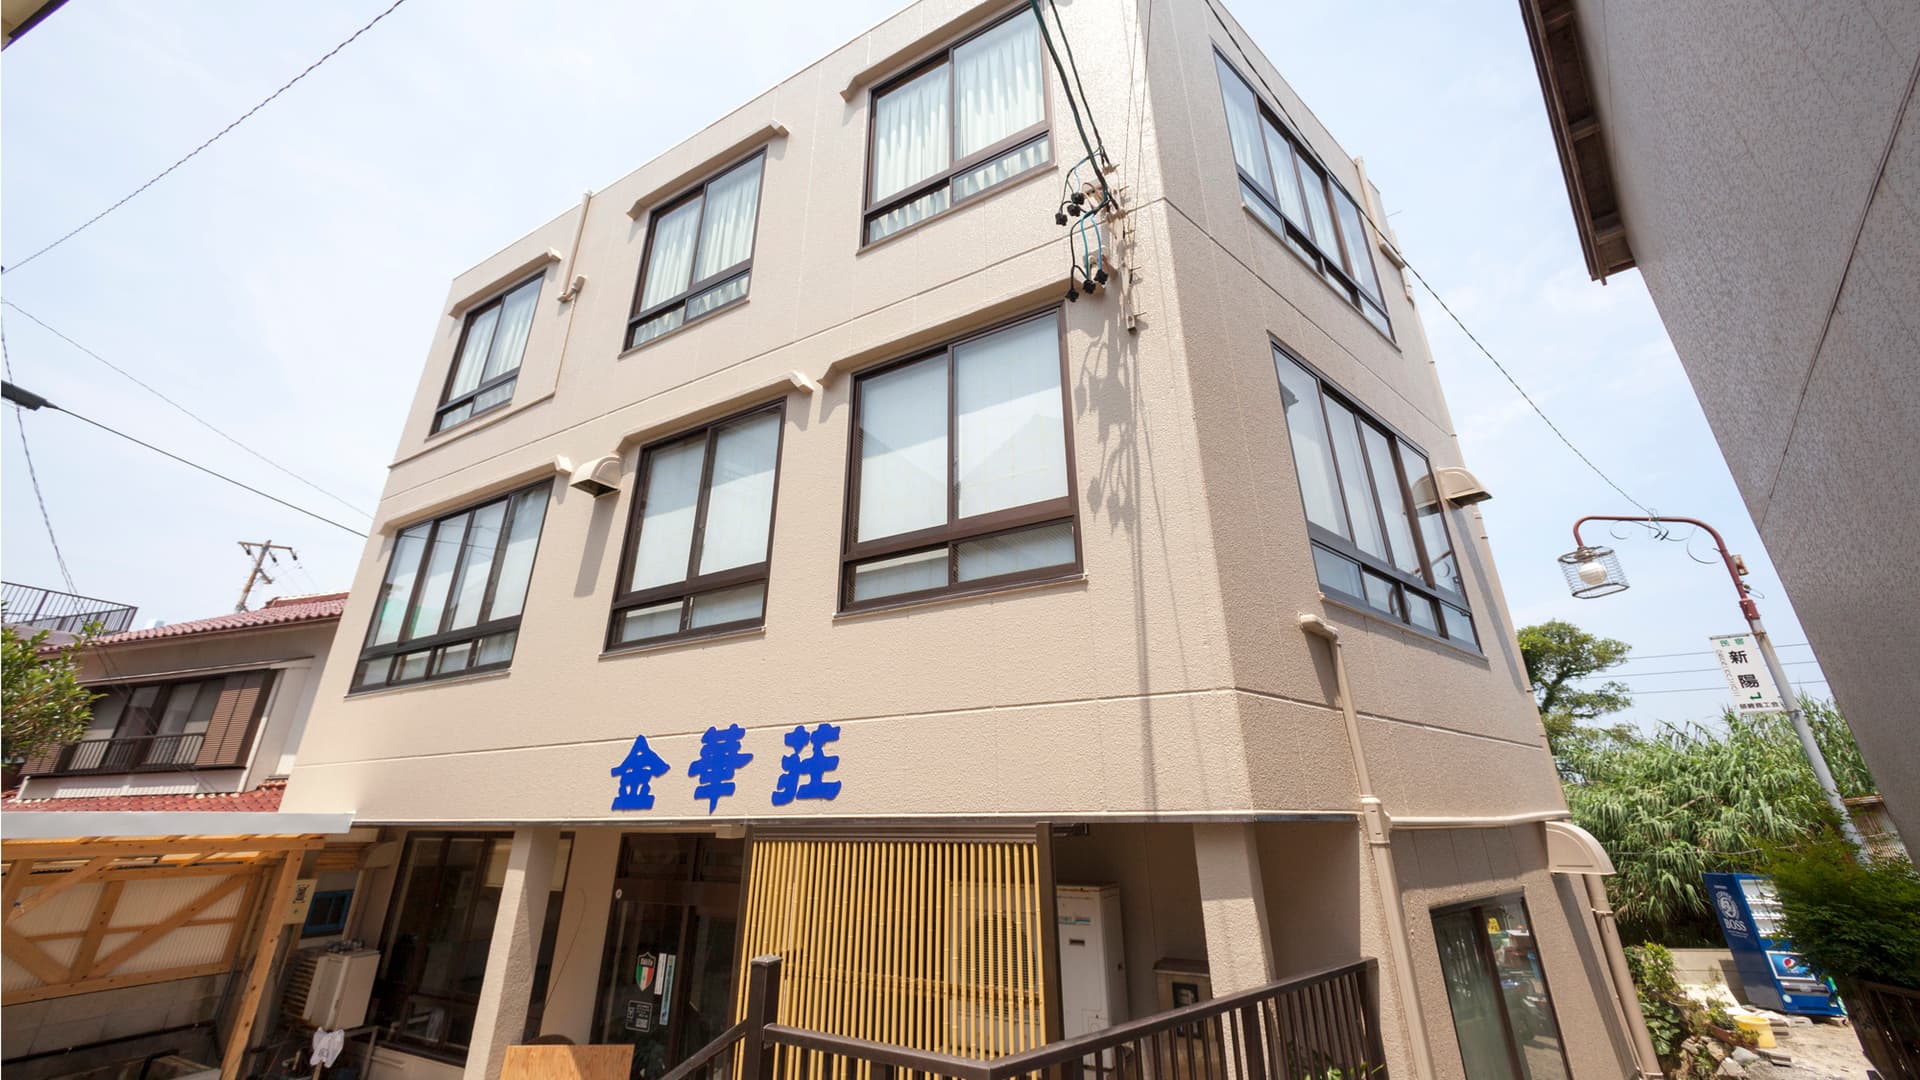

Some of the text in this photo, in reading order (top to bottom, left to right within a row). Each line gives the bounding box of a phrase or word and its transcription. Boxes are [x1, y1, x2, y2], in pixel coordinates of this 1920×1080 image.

[1728, 650, 1760, 689] 新陽
[611, 723, 842, 815] 金華荘
[1723, 918, 1747, 932] BOSS
